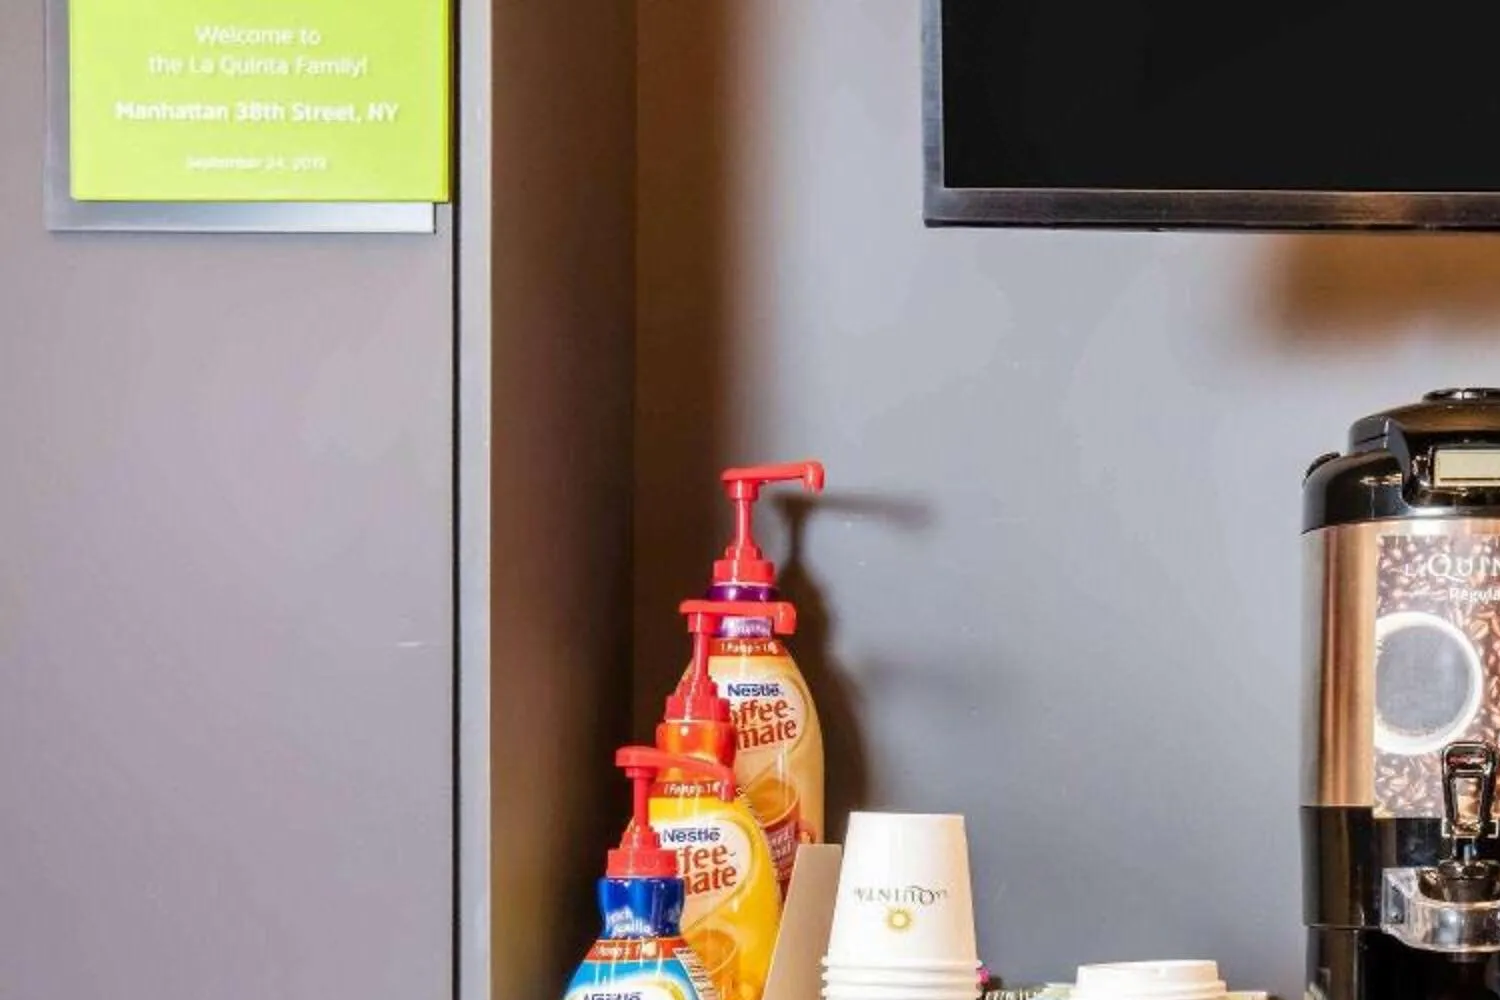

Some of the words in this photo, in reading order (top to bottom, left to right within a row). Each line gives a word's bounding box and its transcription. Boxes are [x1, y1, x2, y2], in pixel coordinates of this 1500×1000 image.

[194, 24, 293, 45] Welcome
[300, 26, 321, 45] to
[148, 52, 182, 73] the
[189, 54, 215, 74] La
[220, 54, 289, 76] Quinta
[295, 54, 368, 78] Family!
[114, 101, 229, 121] Manhattan
[235, 101, 285, 121] 38th
[291, 102, 362, 123] Street,
[367, 102, 400, 121] NY
